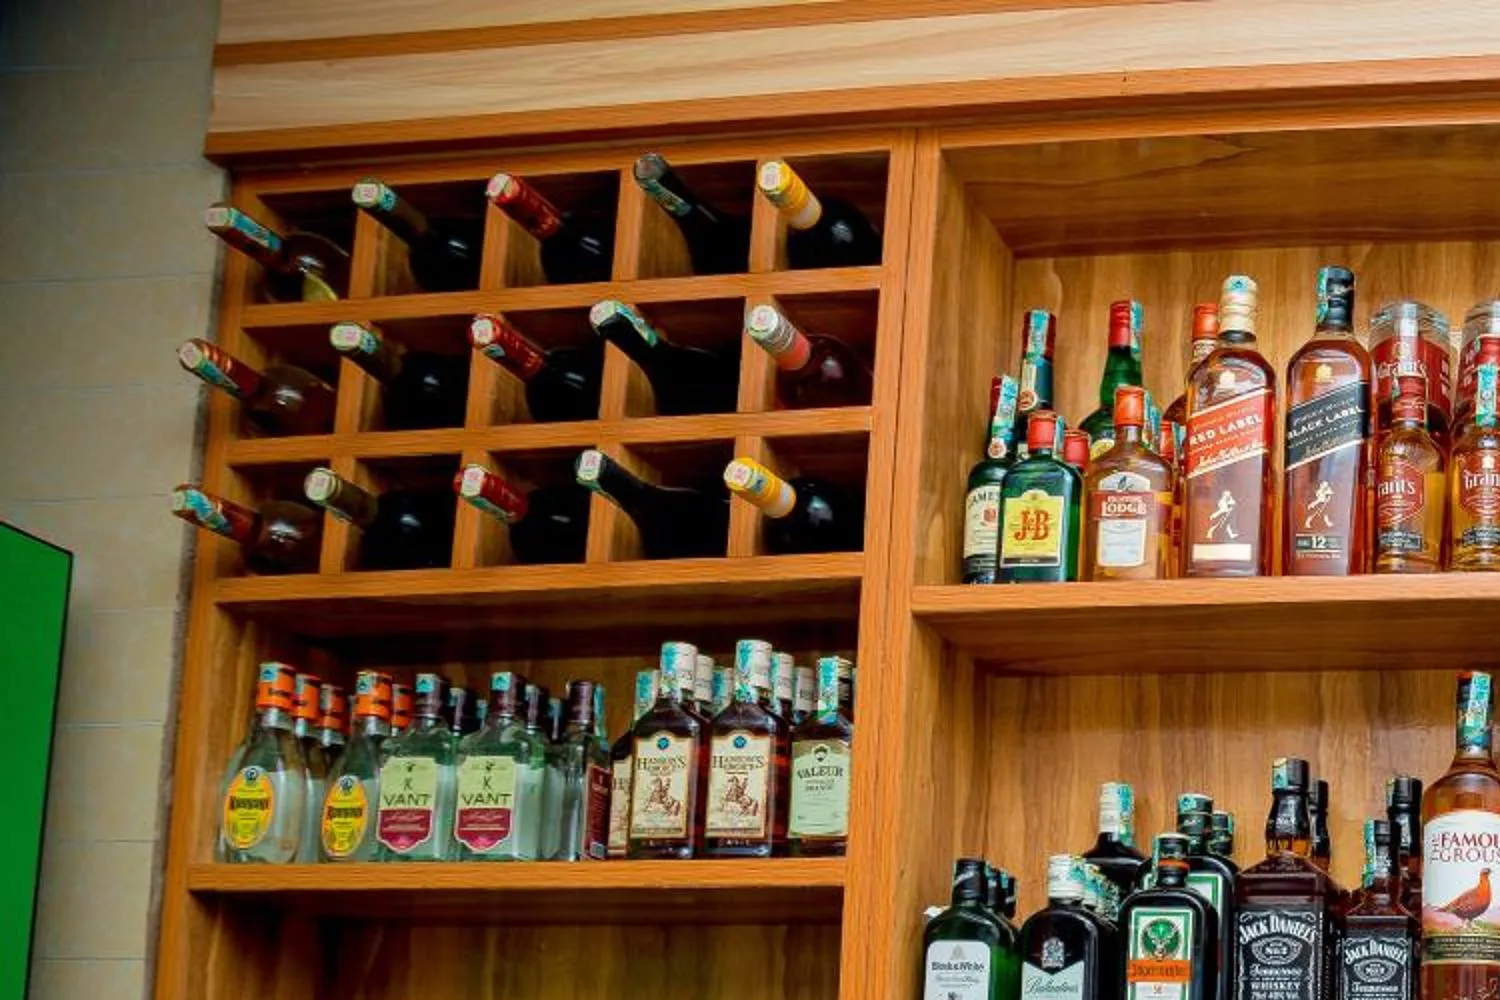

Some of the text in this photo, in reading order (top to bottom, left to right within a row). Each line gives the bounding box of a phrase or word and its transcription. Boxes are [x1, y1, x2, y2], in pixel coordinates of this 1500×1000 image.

[1189, 413, 1263, 447] RED LABEL
[1287, 419, 1325, 441] BLACK
[1325, 405, 1366, 424] LABEL
[1377, 478, 1416, 496] rant's
[1101, 500, 1148, 516] LODGE
[1015, 508, 1050, 541] J&B
[1311, 535, 1327, 549] 12
[383, 792, 431, 807] VANT
[460, 792, 512, 806] VANT
[1239, 917, 1269, 946] JACK
[1250, 981, 1301, 990] WHISKEY
